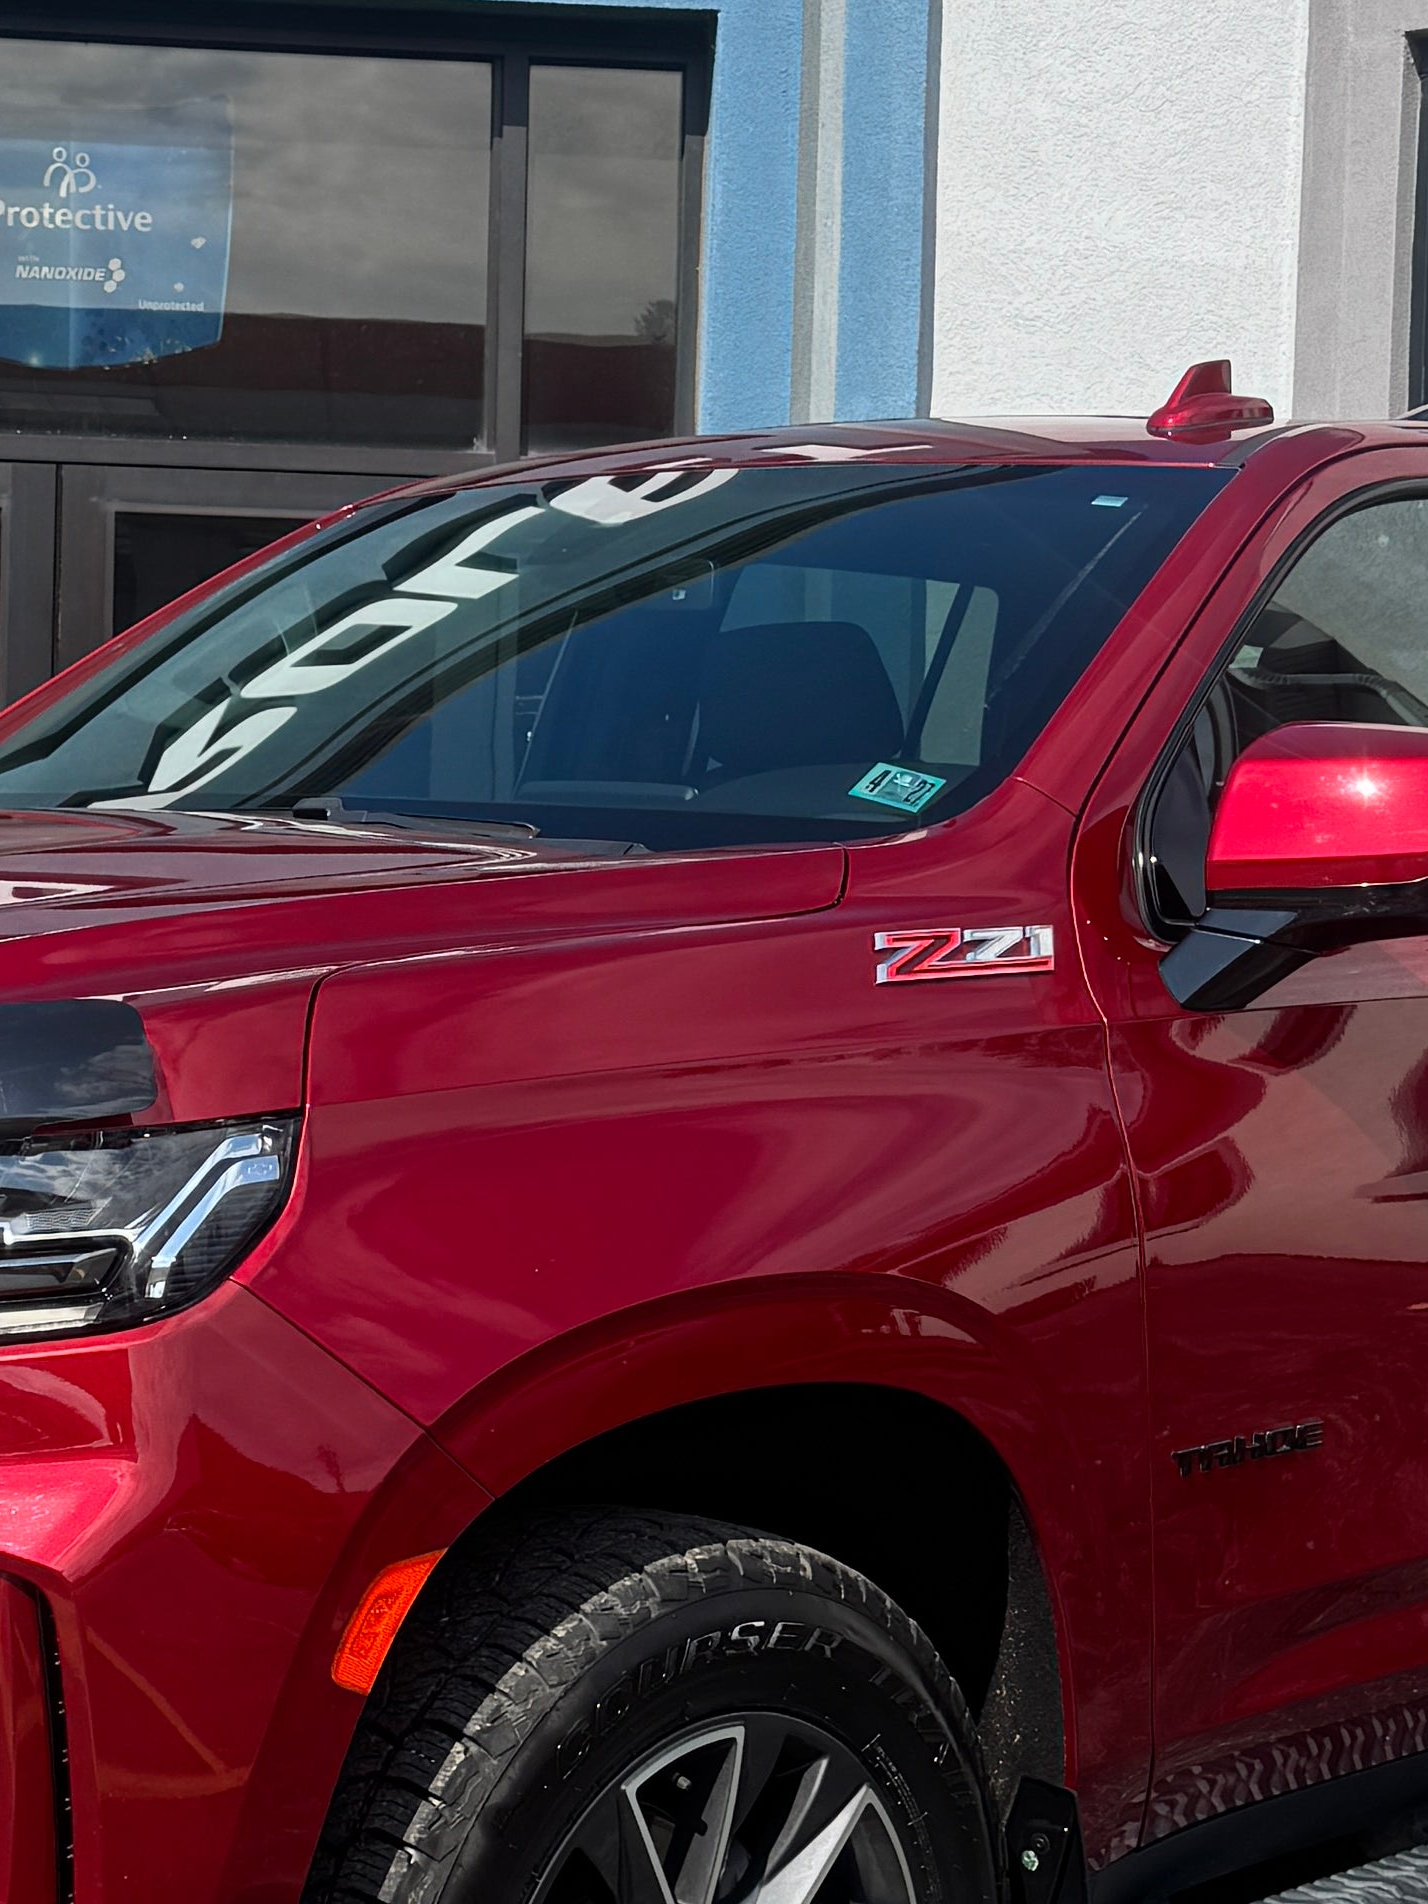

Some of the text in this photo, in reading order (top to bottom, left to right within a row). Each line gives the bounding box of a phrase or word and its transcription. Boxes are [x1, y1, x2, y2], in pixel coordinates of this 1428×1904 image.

[15, 264, 106, 282] NANOXIDE
[138, 299, 204, 312] Unprotected
[874, 924, 1055, 985] Z71
[555, 1619, 845, 1782] COURSER
